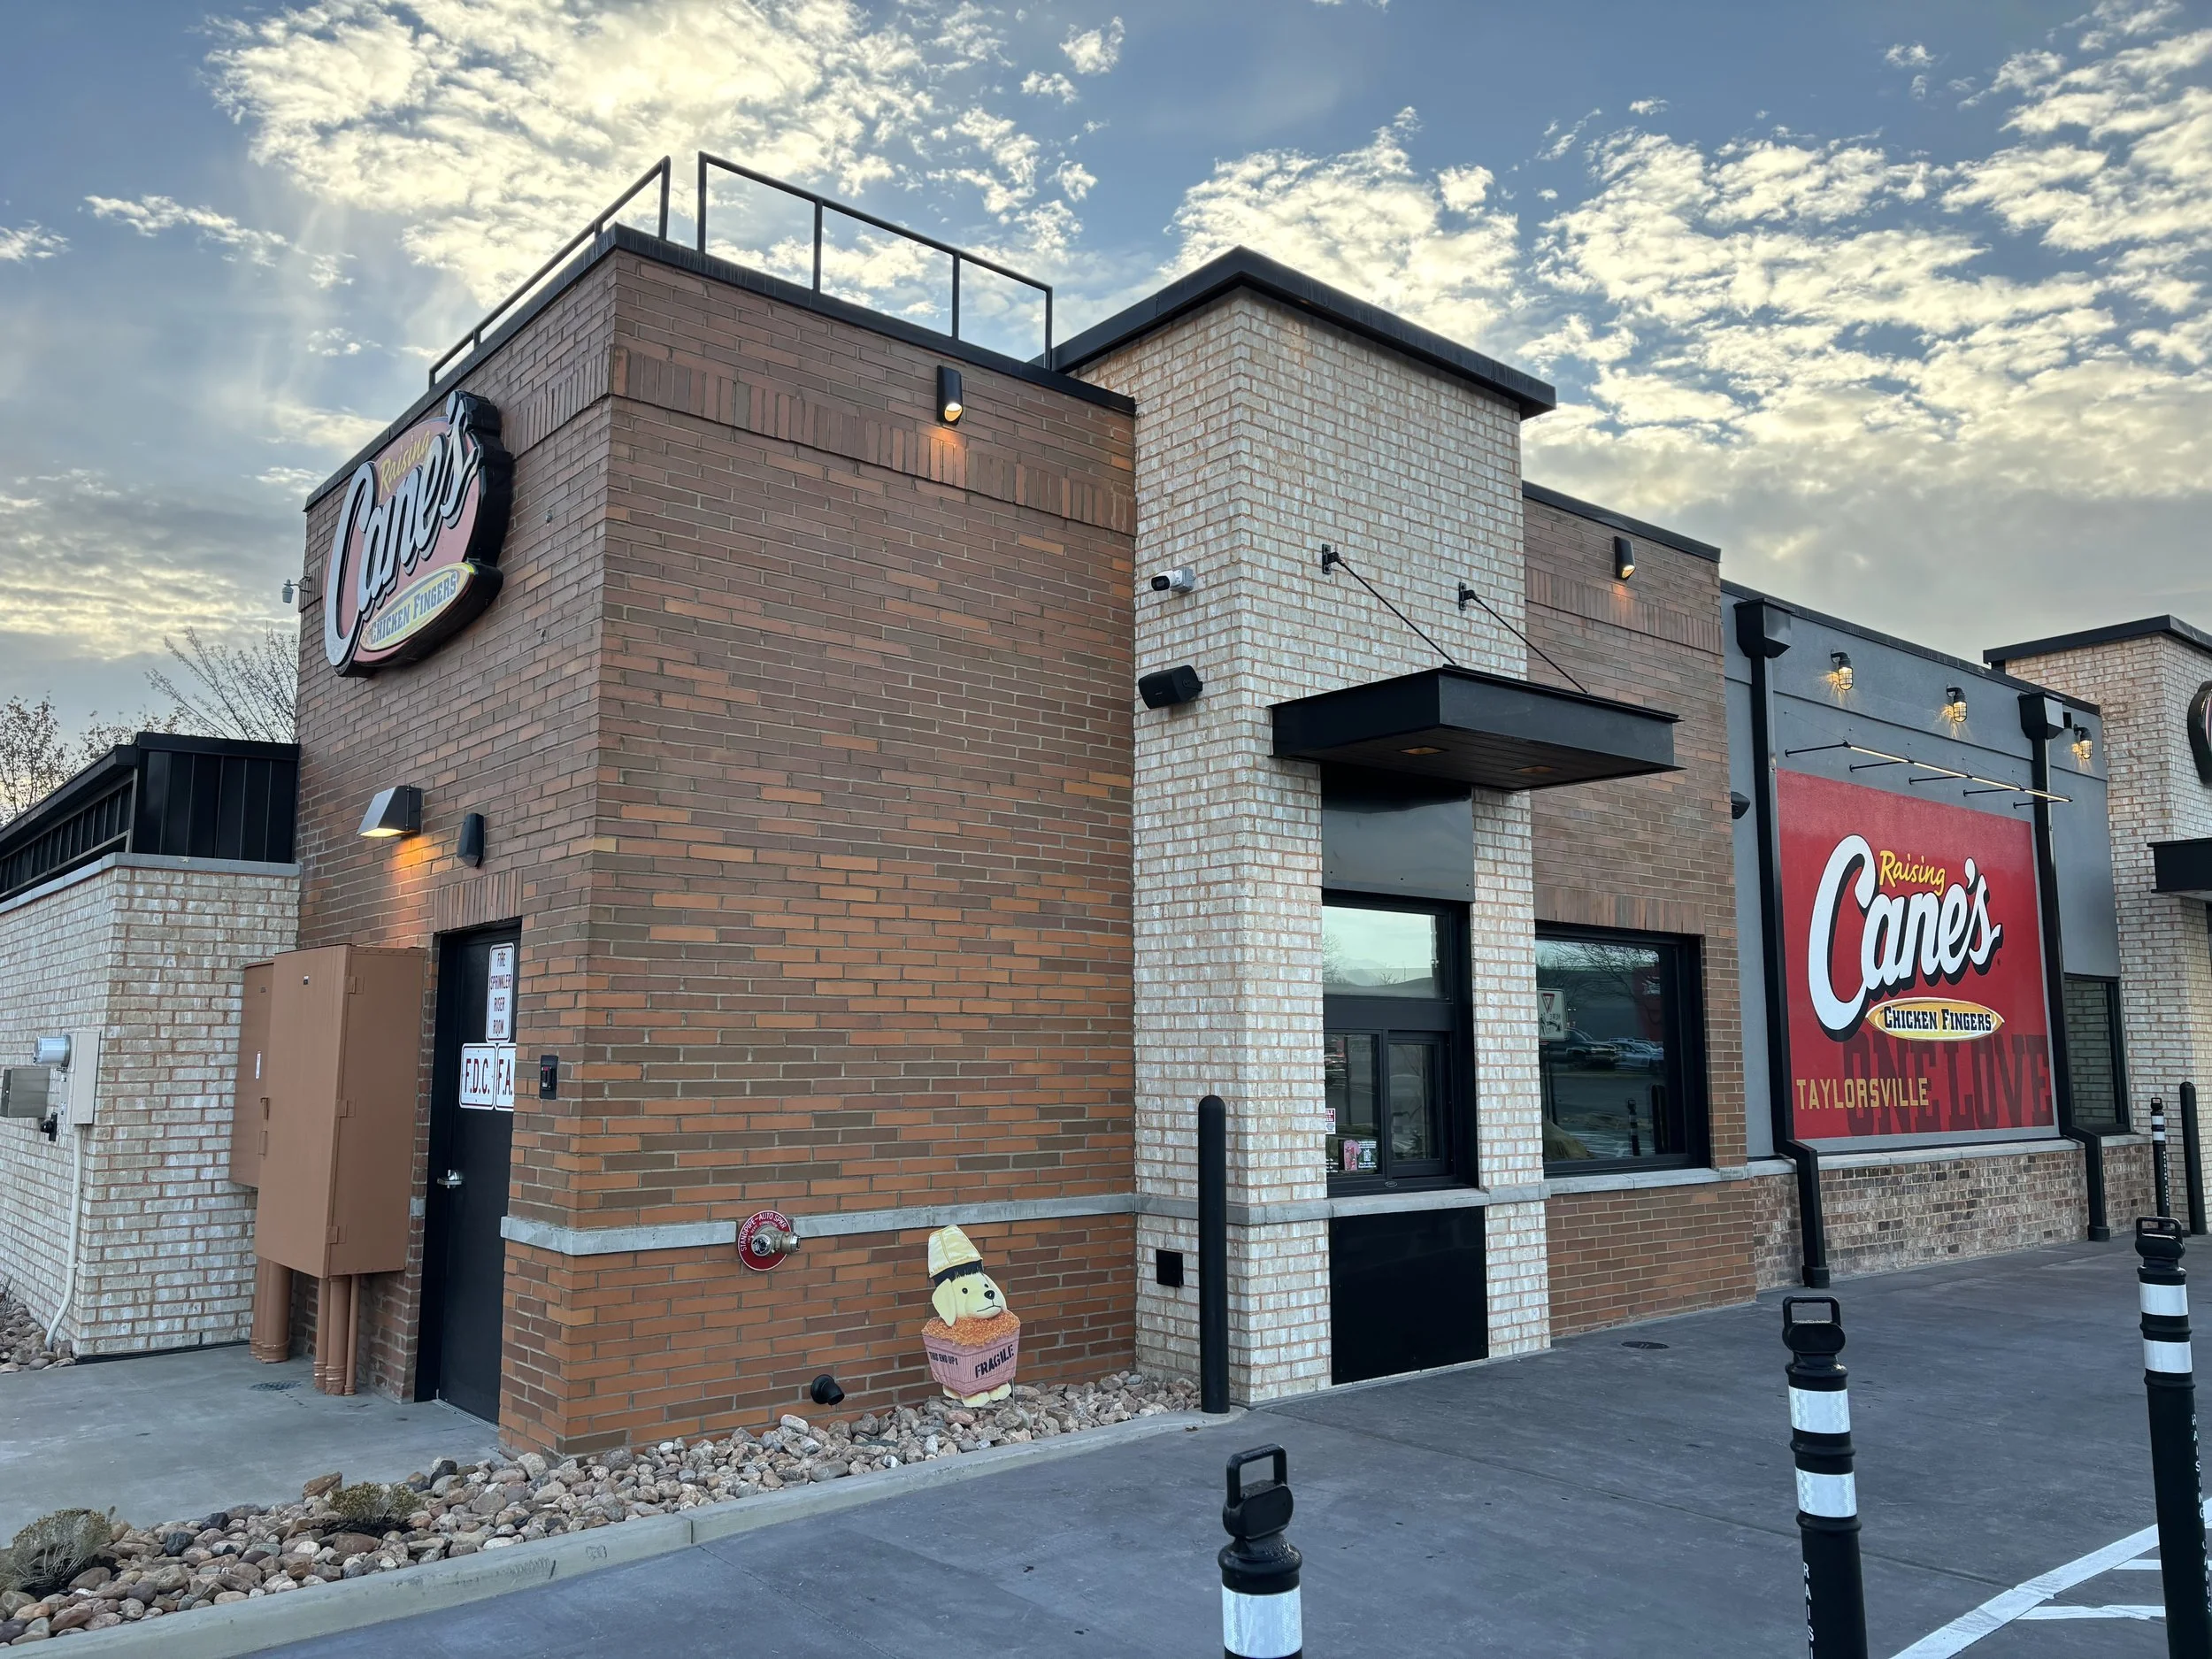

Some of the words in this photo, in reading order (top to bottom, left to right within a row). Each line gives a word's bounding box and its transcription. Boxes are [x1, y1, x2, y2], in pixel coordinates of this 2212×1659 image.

[379, 430, 431, 503] Raising
[325, 389, 480, 669] Cane's
[371, 603, 411, 645] CHICKEN
[413, 572, 457, 620] FINGERS
[1879, 850, 1946, 896] Raising
[1808, 834, 2003, 1037] Cane's
[490, 974, 512, 990] SPRINKLER
[494, 997, 505, 1011] RISER
[1884, 1006, 1938, 1030] CHICKEN
[1941, 1009, 1992, 1031] FINGERS
[465, 1057, 490, 1094] F.D.C.
[1796, 1077, 1929, 1110] TAYLORSVILLE
[1843, 1030, 1941, 1137] ONE
[1943, 1033, 2055, 1132] LOVE
[975, 1344, 1015, 1379] FRAGILE
[2192, 1413, 2205, 1519] RAISING
